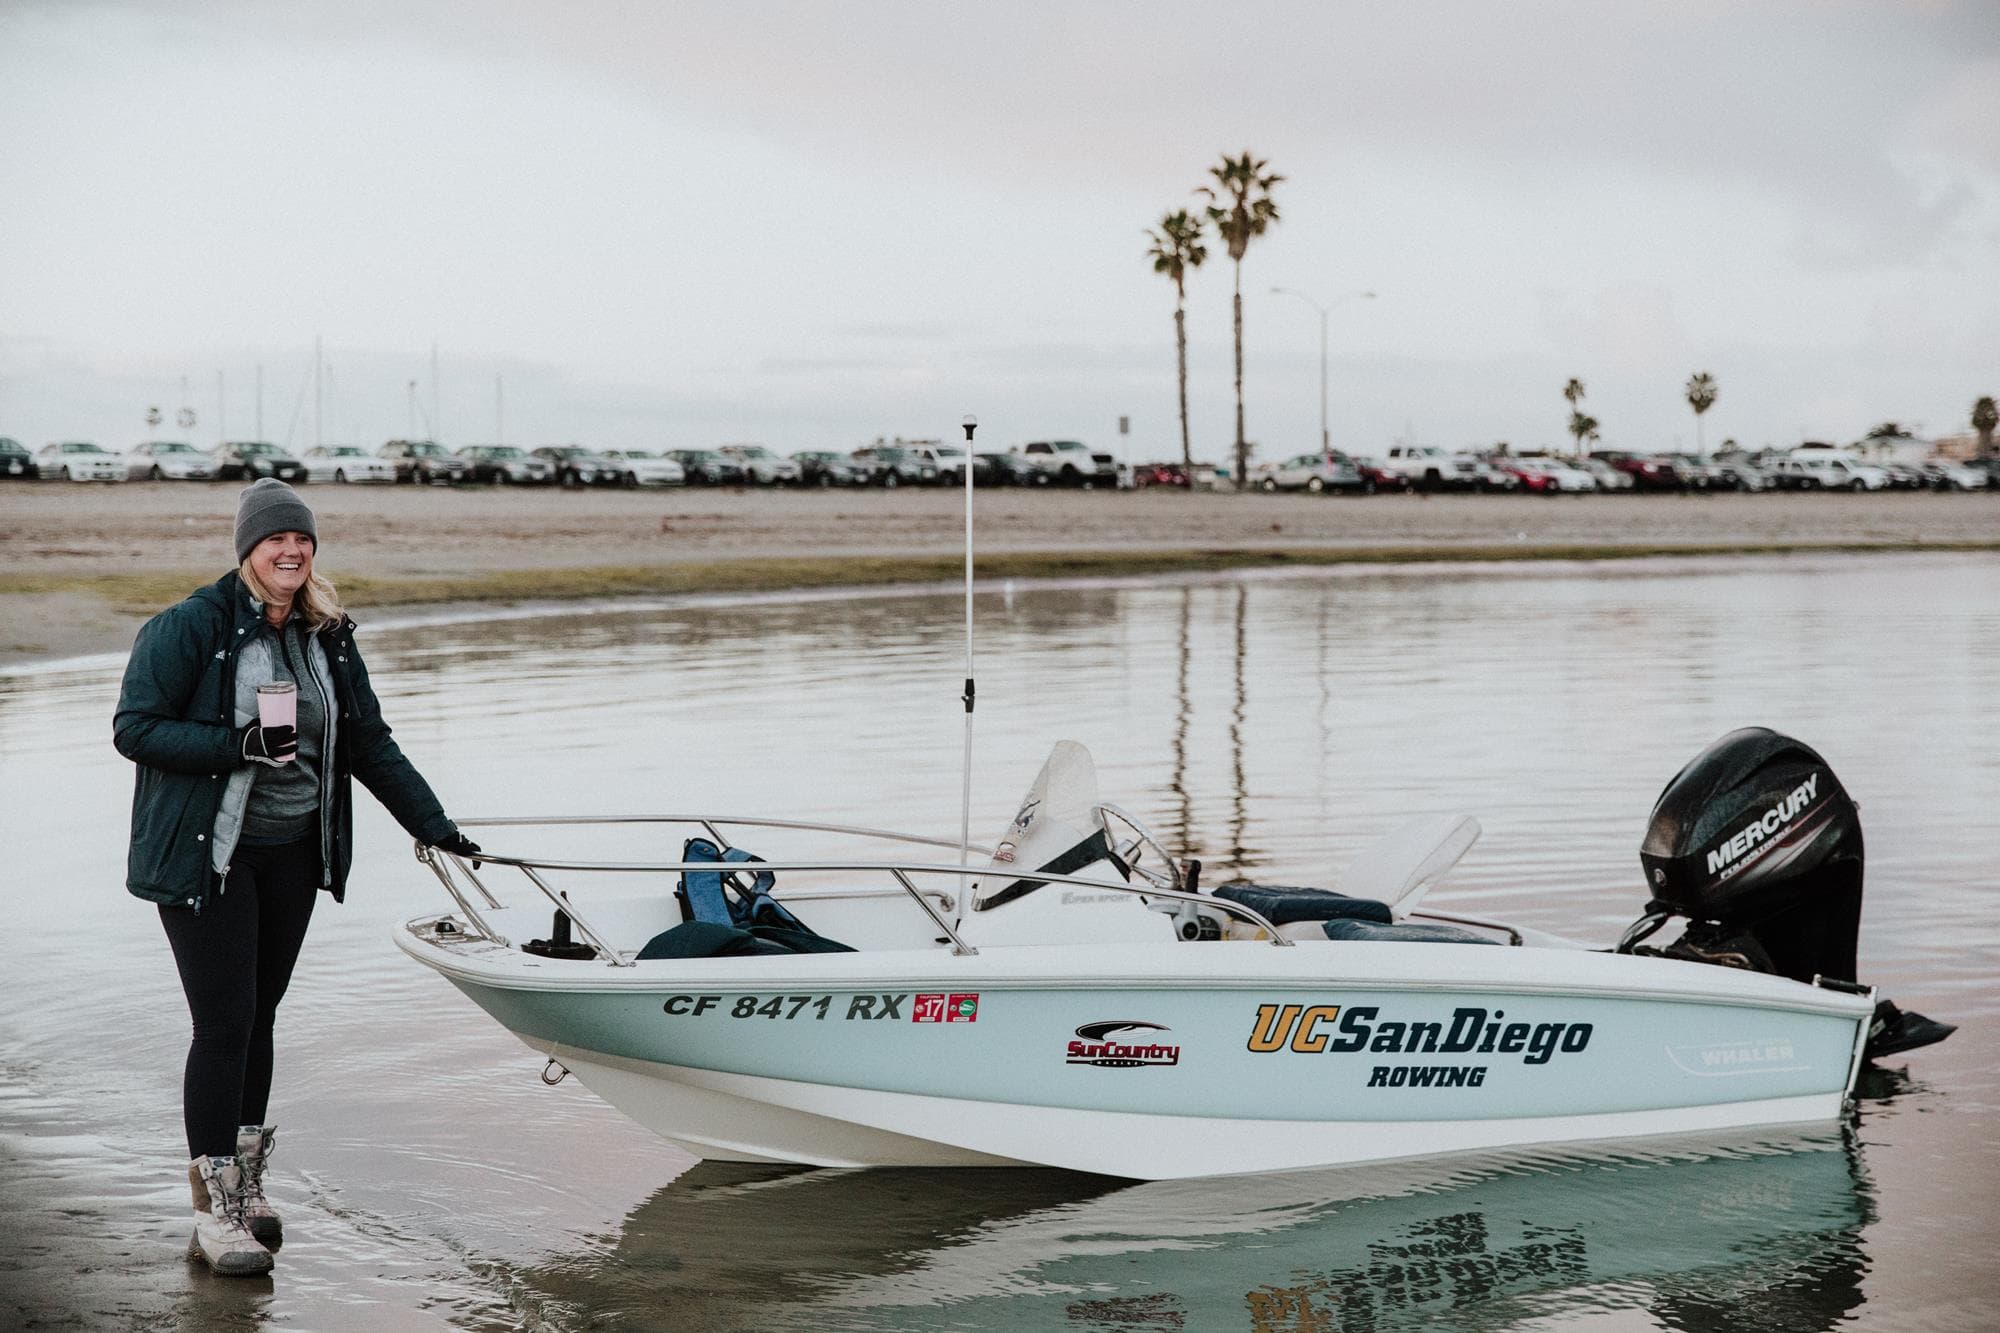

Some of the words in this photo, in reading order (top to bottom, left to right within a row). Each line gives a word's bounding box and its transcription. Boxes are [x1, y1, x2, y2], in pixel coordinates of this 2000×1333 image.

[1707, 772, 1817, 875] MERCURY
[663, 995, 722, 1016] CF
[731, 995, 833, 1019] 8471
[846, 994, 908, 1020] RX
[924, 999, 944, 1017] 17
[1066, 1041, 1180, 1066] SunCountry
[1367, 1066, 1488, 1088] ROWING
